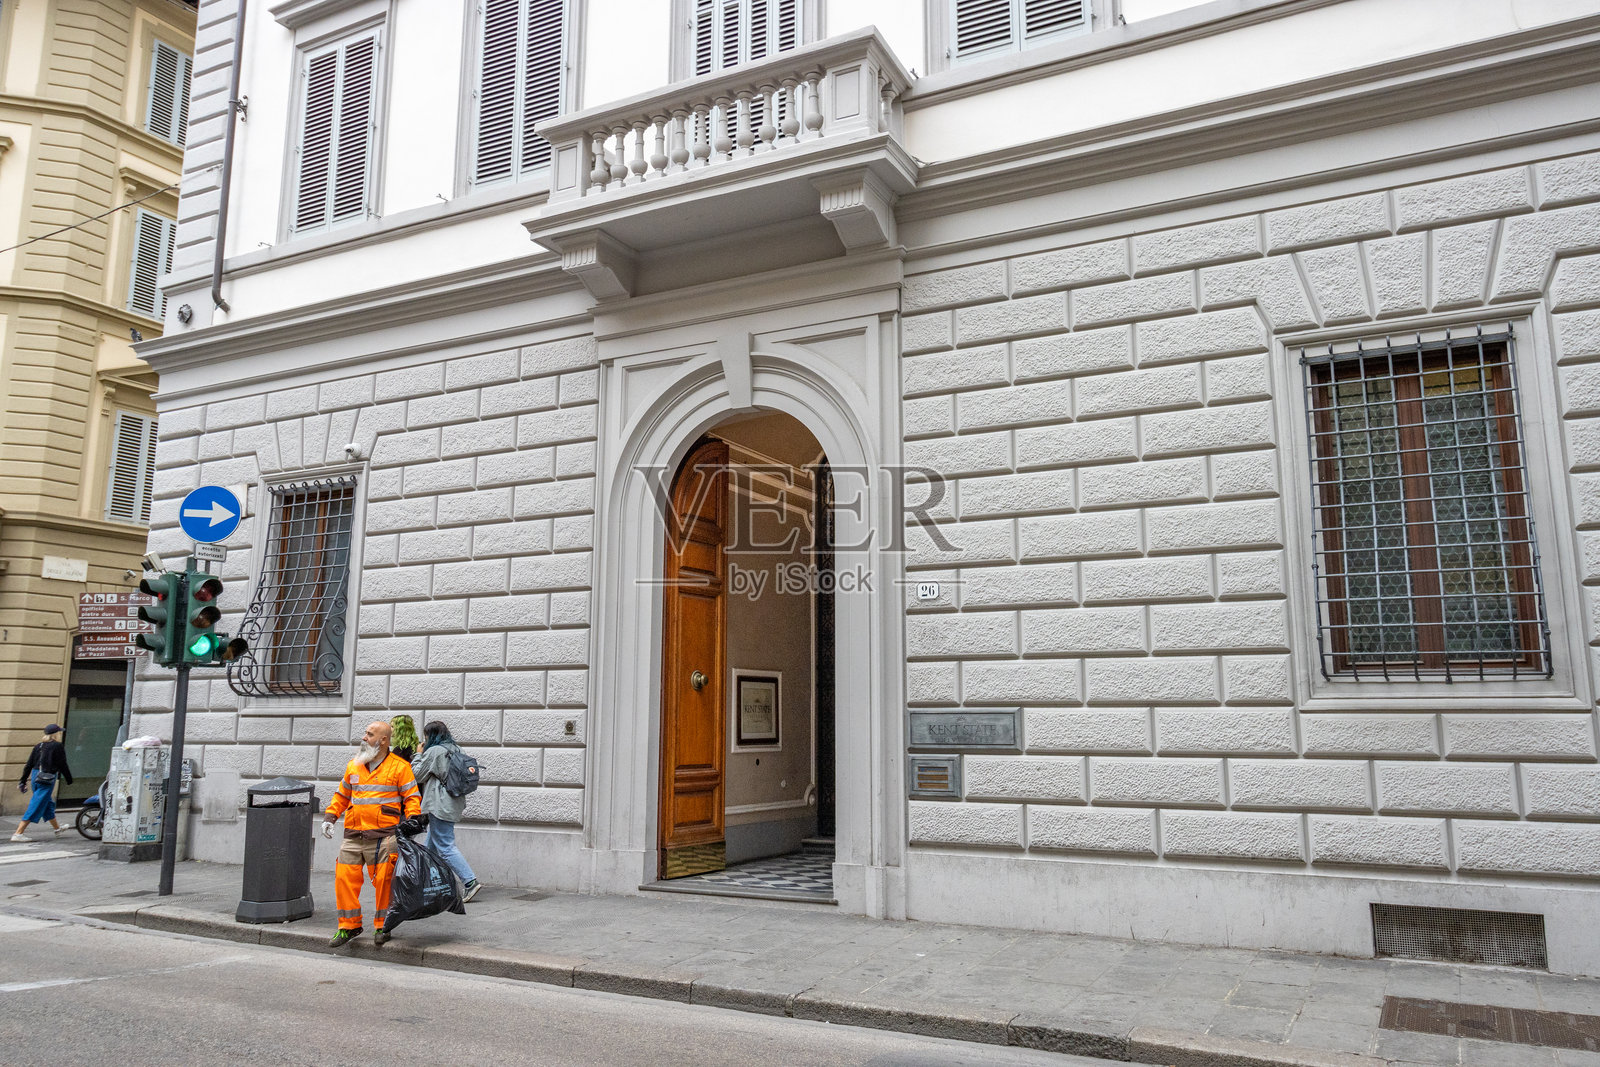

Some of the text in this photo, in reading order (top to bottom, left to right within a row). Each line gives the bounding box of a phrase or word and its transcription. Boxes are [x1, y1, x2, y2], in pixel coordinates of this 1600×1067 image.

[921, 585, 935, 597] 26
[928, 724, 998, 736] KENT STATE
